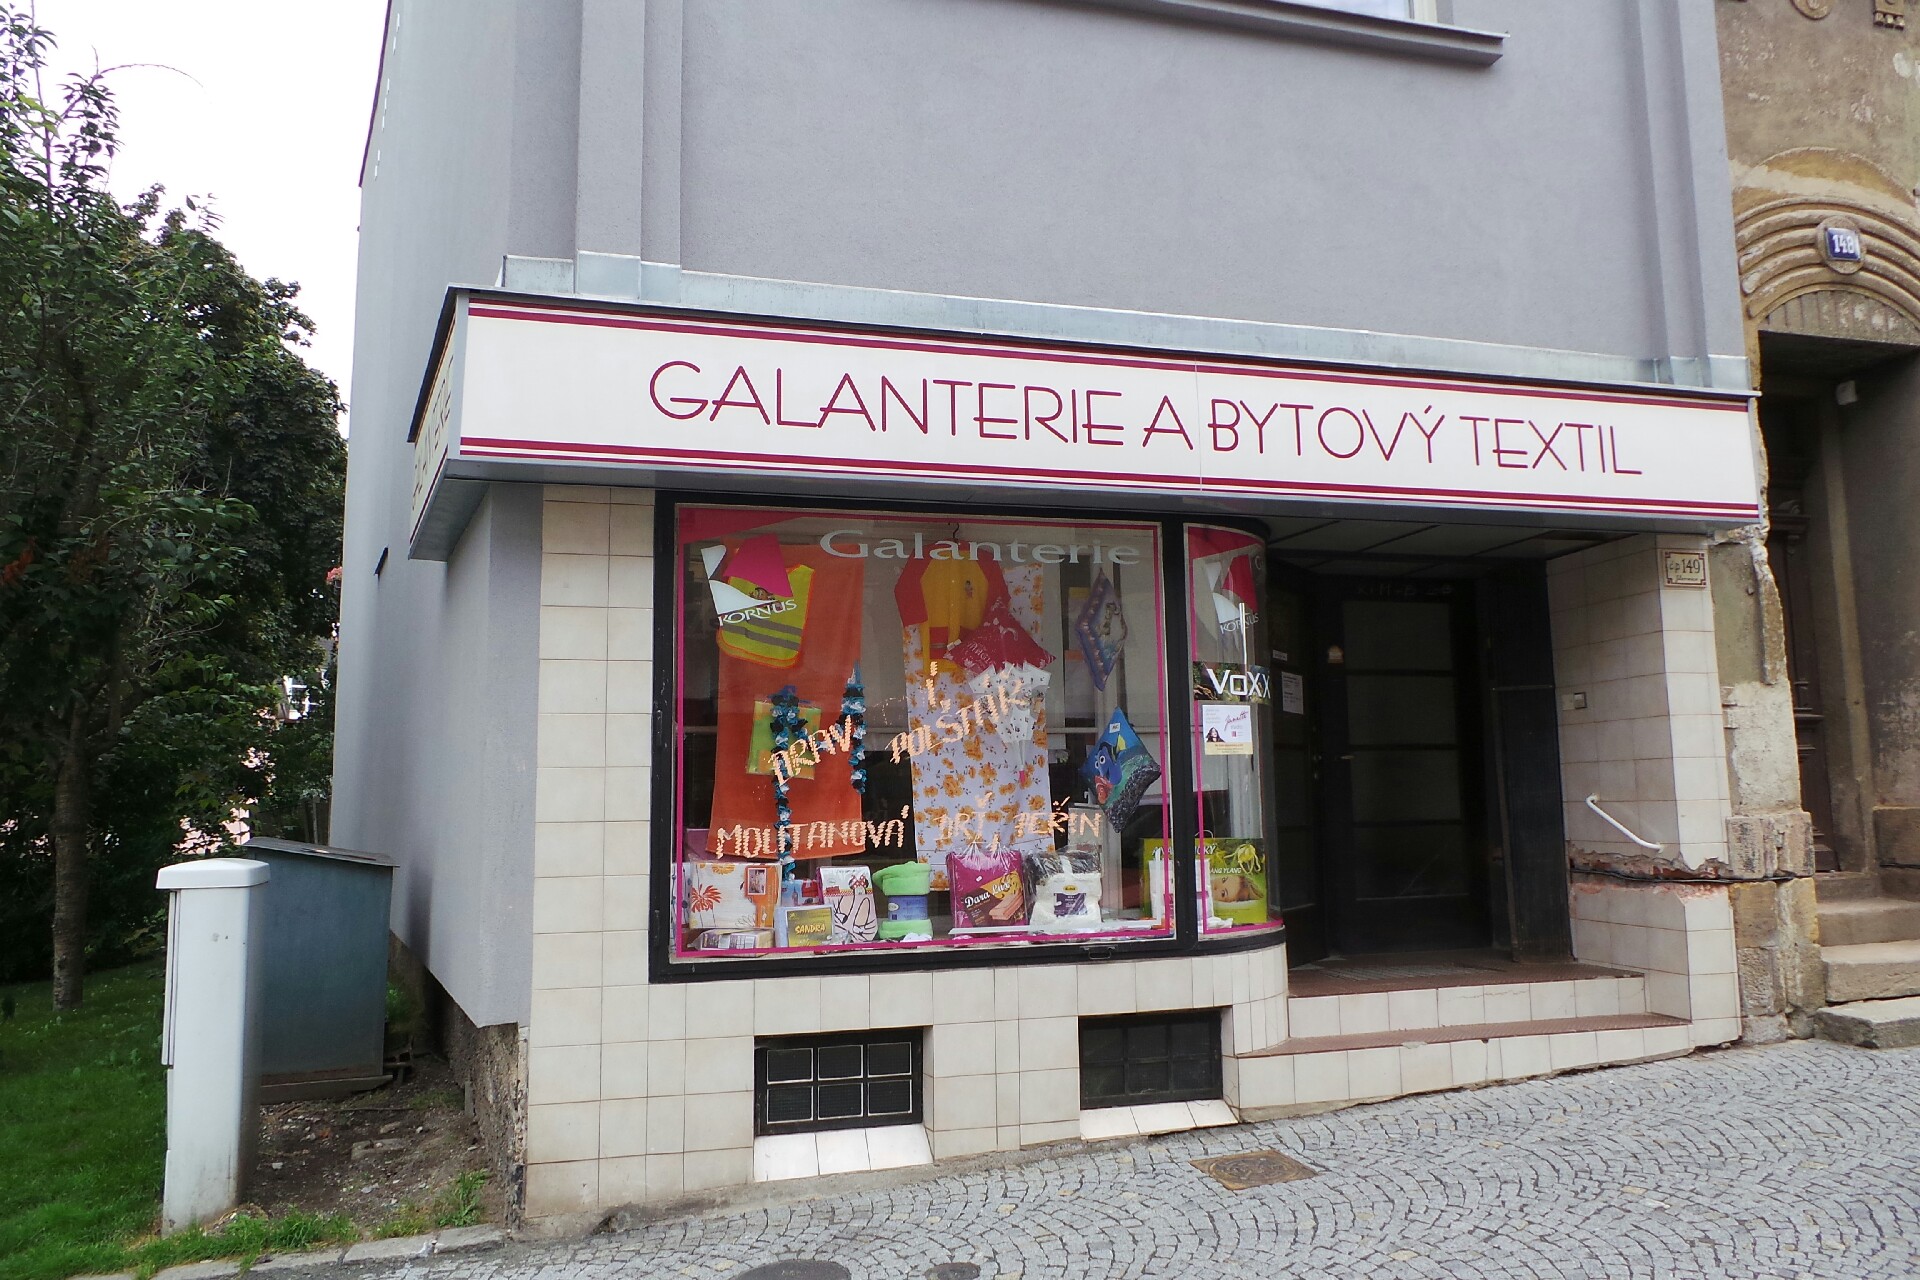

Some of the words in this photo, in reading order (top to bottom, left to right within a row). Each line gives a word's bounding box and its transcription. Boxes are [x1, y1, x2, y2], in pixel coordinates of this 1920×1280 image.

[1832, 234, 1855, 254] 148
[649, 360, 1124, 446] GALANTERIE
[1142, 394, 1193, 451] A
[1206, 398, 1446, 463] BYTOVÝ
[1459, 415, 1643, 476] TEXTIL
[819, 529, 1140, 565] Galanterie
[1681, 558, 1701, 574] 149
[717, 598, 798, 627] KORNUS
[794, 922, 827, 936] SANDRA
